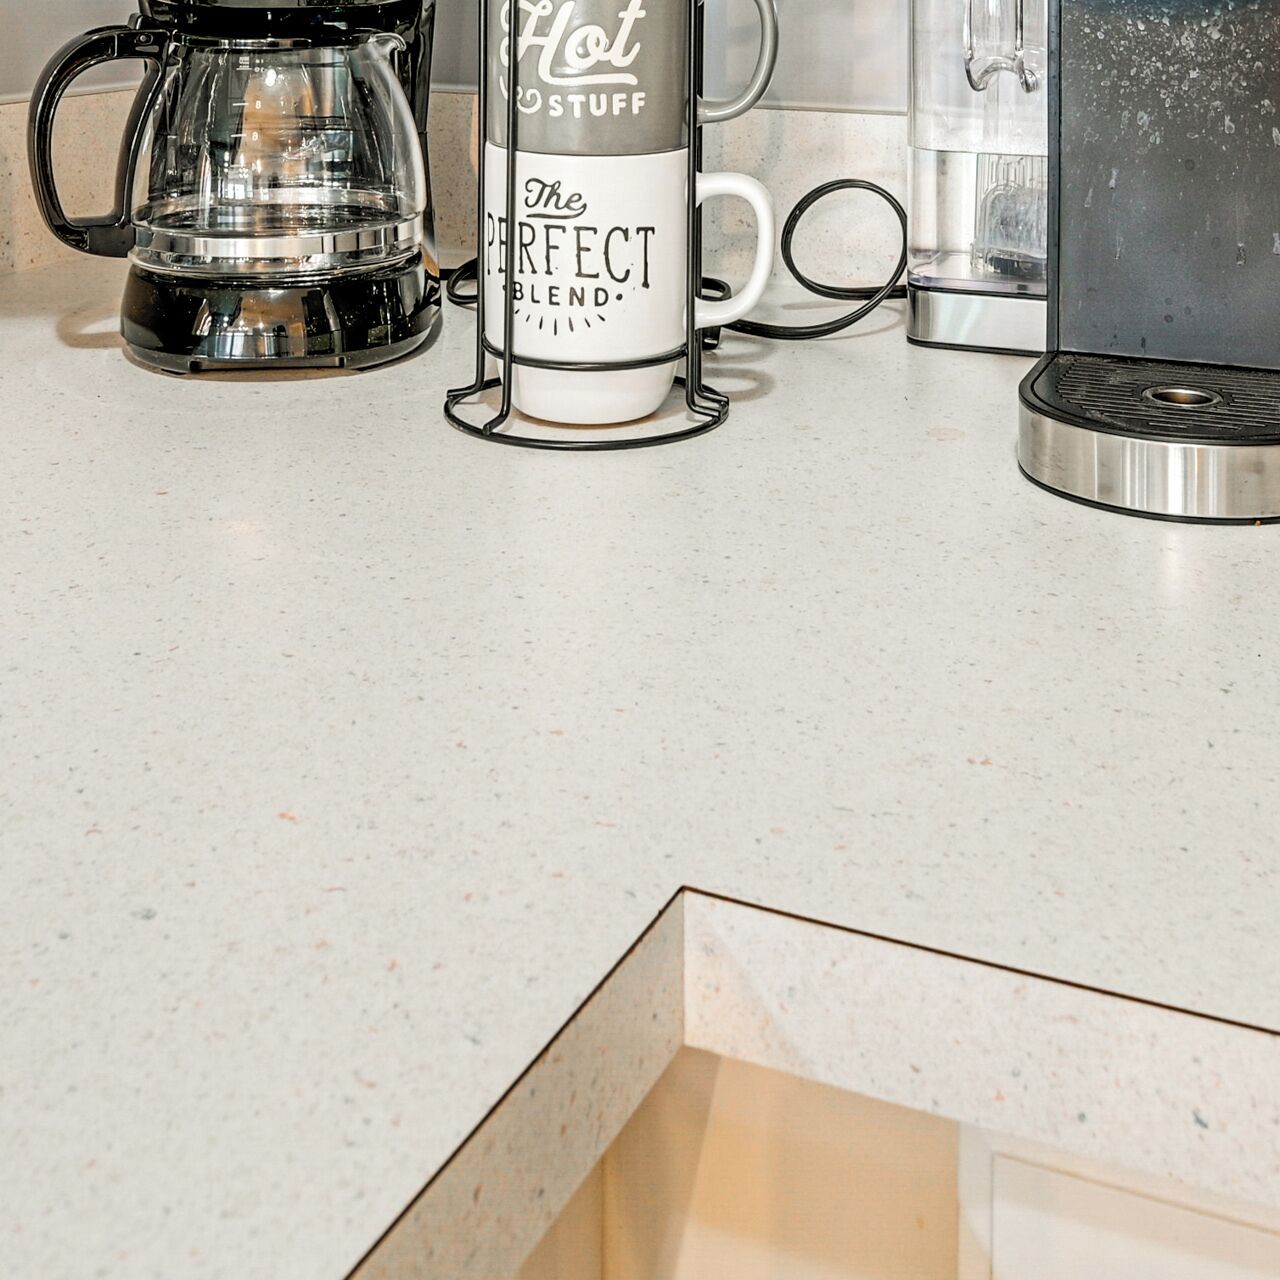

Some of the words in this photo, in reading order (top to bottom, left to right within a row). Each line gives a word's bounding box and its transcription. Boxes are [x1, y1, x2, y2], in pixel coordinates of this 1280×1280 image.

[548, 92, 646, 118] STUFF
[524, 177, 588, 219] The
[487, 212, 656, 289] PERFECT
[512, 281, 609, 307] BLEND
